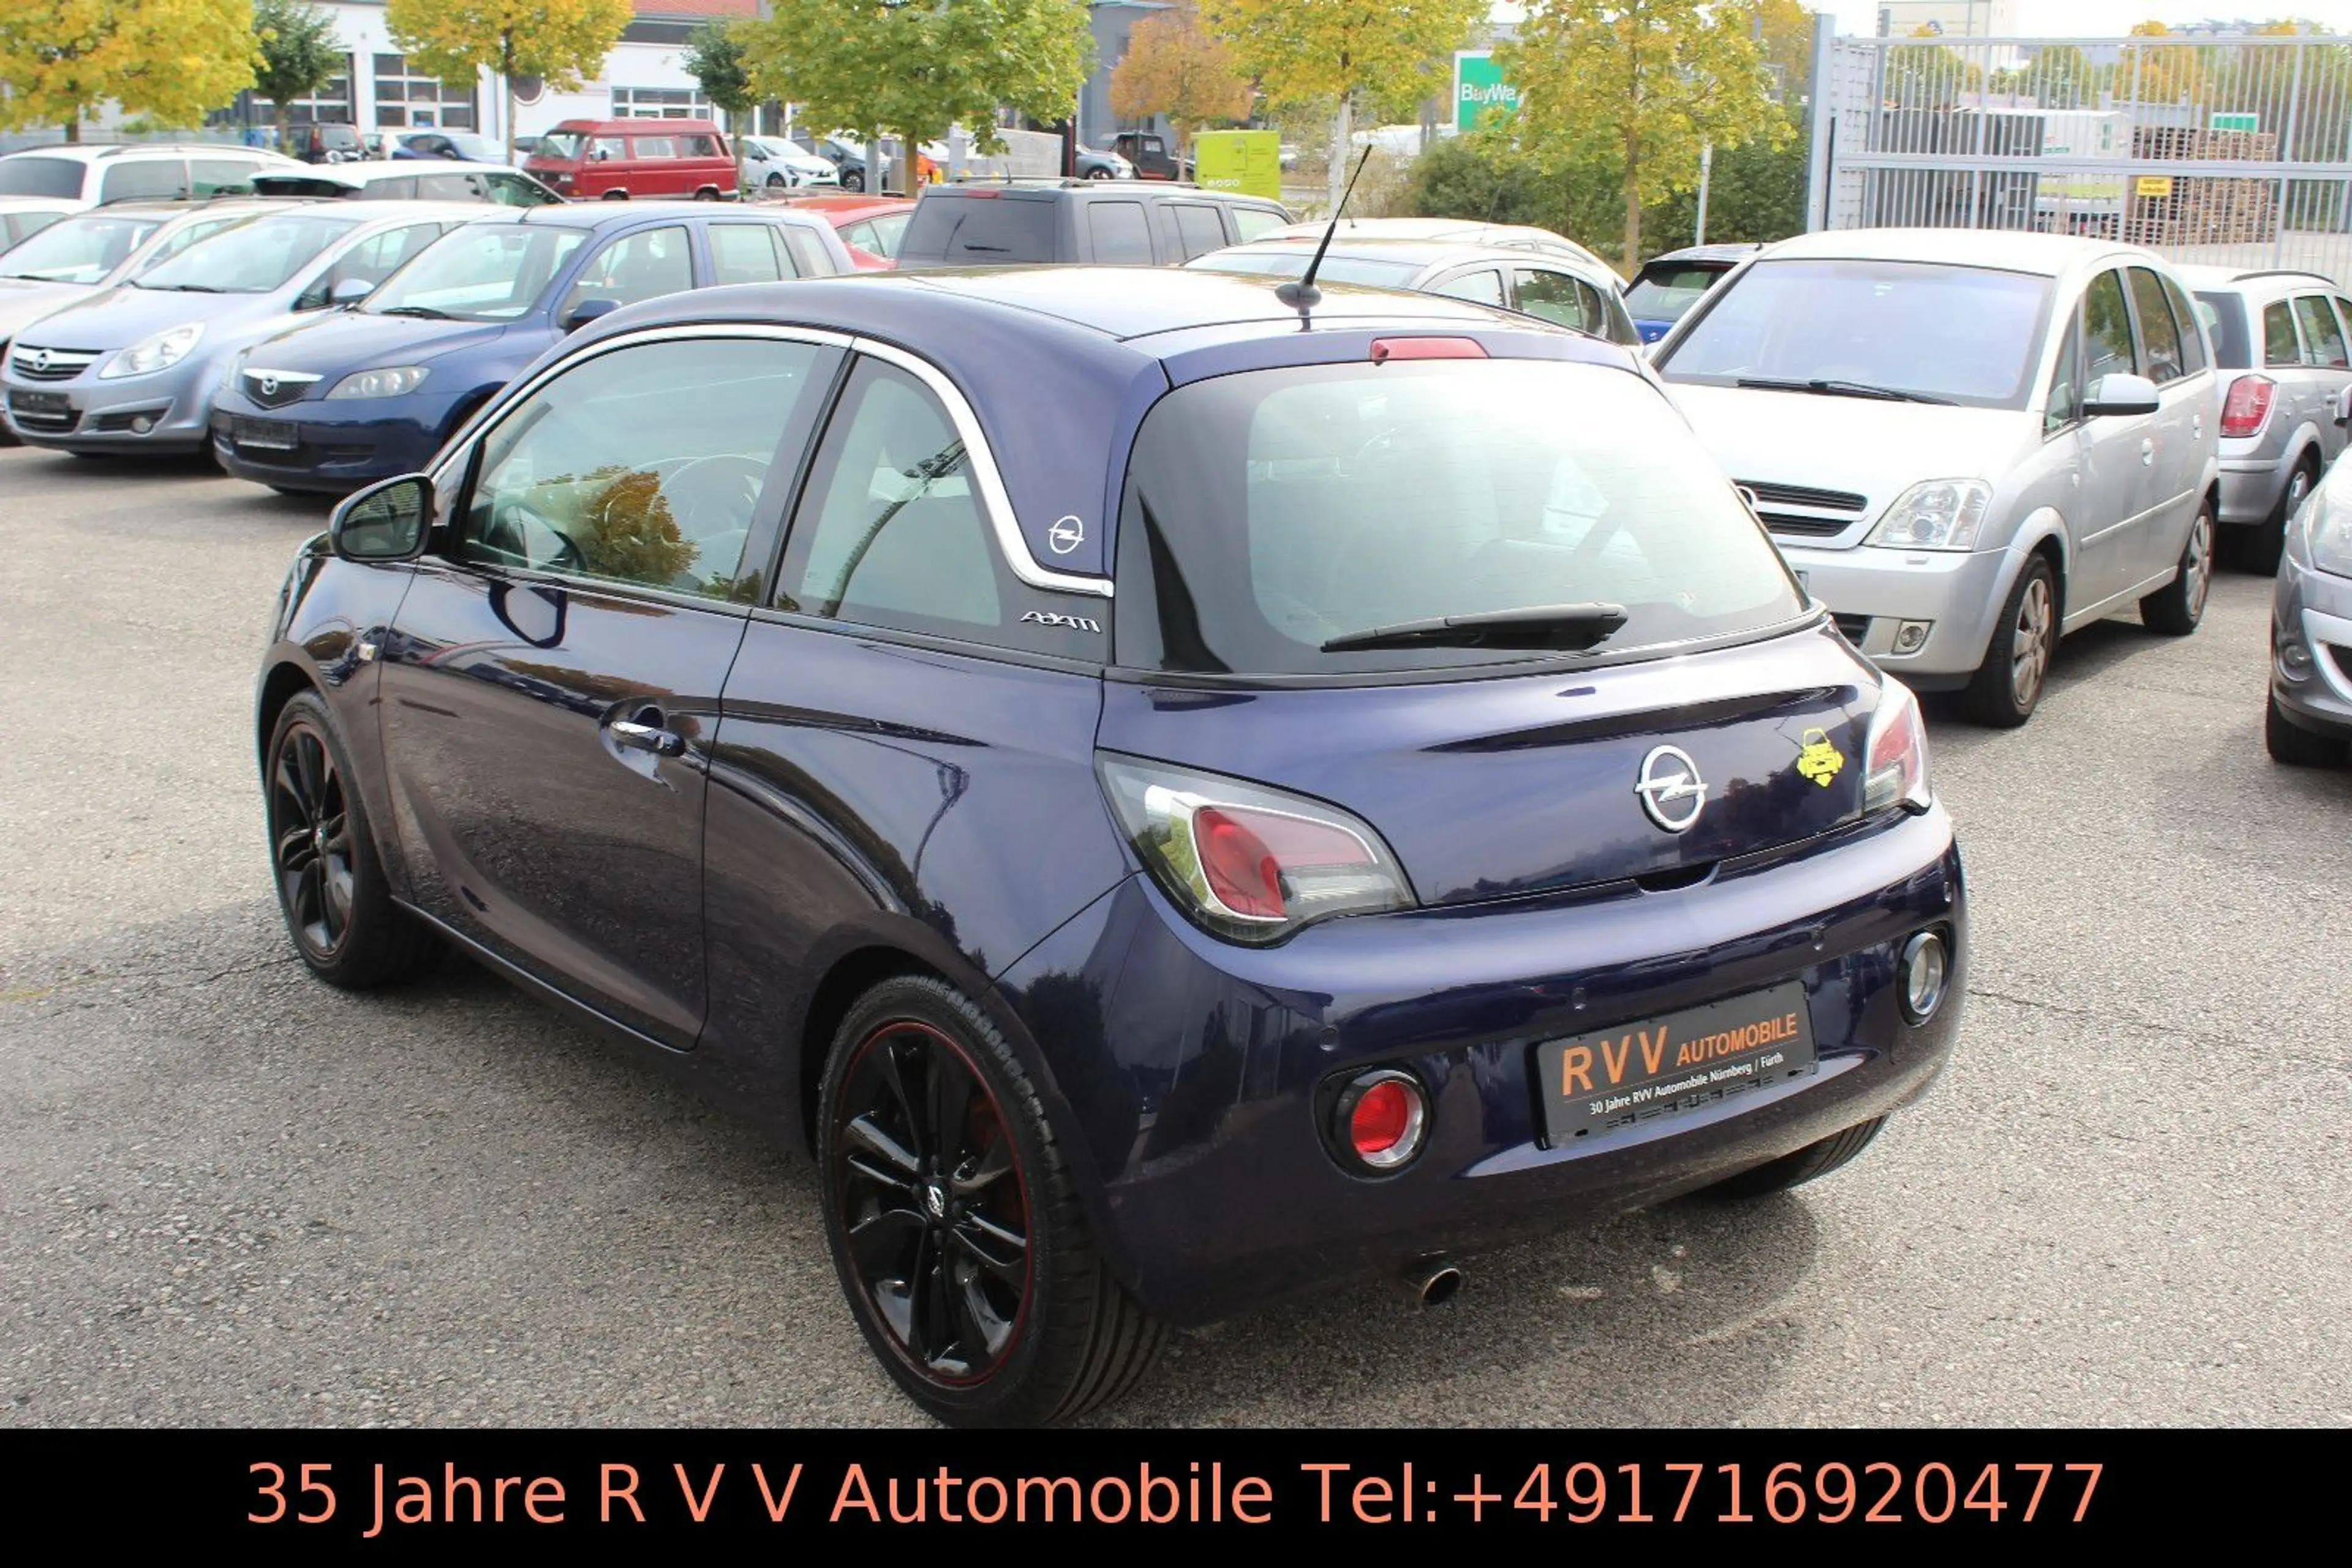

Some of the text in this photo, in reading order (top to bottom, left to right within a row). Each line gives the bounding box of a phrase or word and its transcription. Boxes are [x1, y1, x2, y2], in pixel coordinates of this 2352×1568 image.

[1461, 83, 1516, 104] BayWa
[1676, 1012, 1798, 1066] AUTOMOBILE
[1589, 1051, 1784, 1115] 30 Jahre RVV Automobile Nürnberg / Fürth
